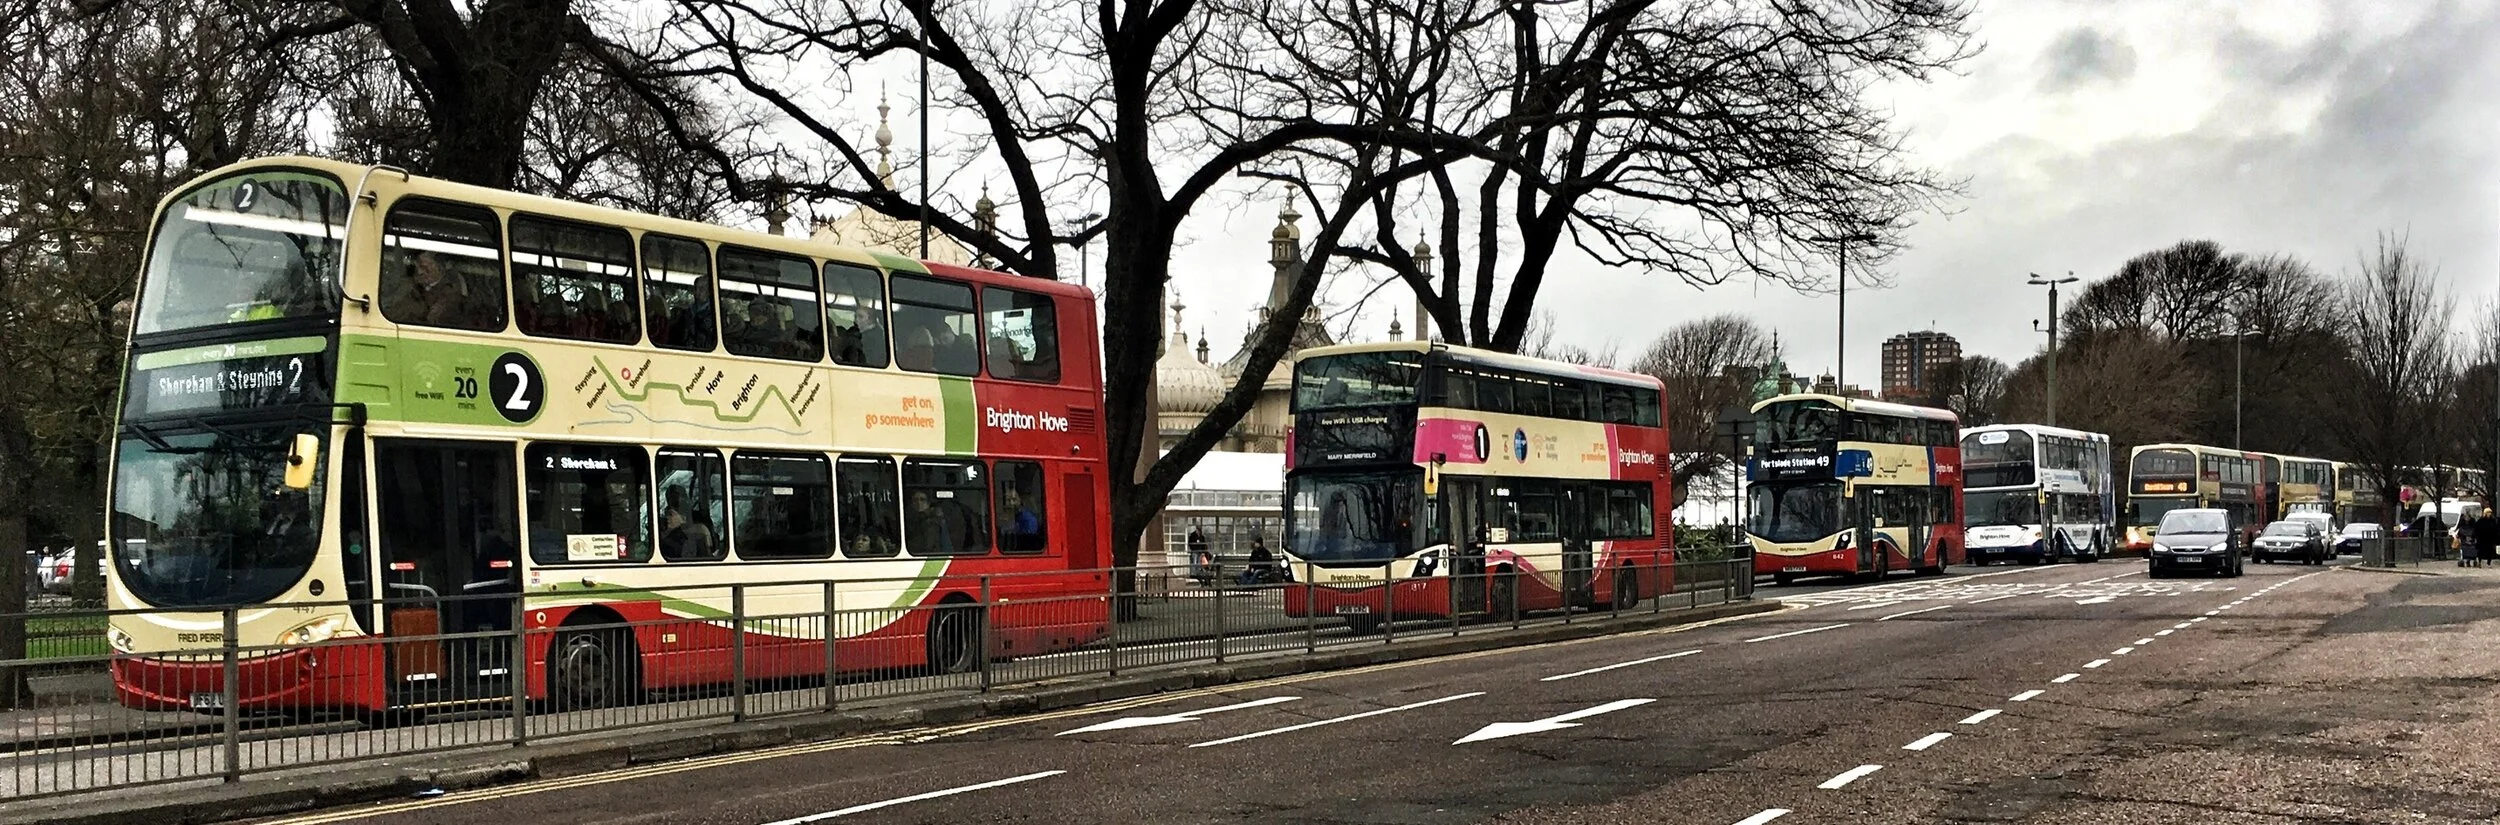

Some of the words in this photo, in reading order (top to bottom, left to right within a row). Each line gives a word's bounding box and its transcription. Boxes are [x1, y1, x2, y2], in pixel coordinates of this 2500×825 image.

[238, 183, 253, 208] 2
[159, 375, 214, 397] Shoreham
[217, 372, 226, 392] &
[229, 367, 283, 391] Steyning
[289, 357, 303, 394] 2
[455, 367, 475, 376] every
[575, 366, 597, 393] Steyning
[629, 359, 652, 389] Shoreham
[685, 366, 705, 393] Portslade
[706, 370, 724, 394] Hove
[415, 391, 429, 400] free
[454, 377, 478, 399] 20
[504, 363, 531, 410] 2
[586, 382, 607, 409] Bramber
[732, 374, 759, 411] Brighton
[902, 396, 917, 411] get
[919, 398, 934, 411] on,
[865, 414, 878, 430] go
[880, 412, 934, 428] somewhere
[986, 407, 1036, 433] Brighton
[1040, 411, 1069, 432] Hove
[1478, 428, 1485, 458] 1
[545, 456, 554, 468] 2
[560, 456, 609, 470] Shoreham
[1619, 448, 1641, 467] Brighton
[1641, 450, 1655, 465] Hove
[1761, 459, 1791, 469] Portslade
[1792, 457, 1816, 468] Station
[1816, 455, 1830, 467] 49
[178, 633, 198, 643] FRED
